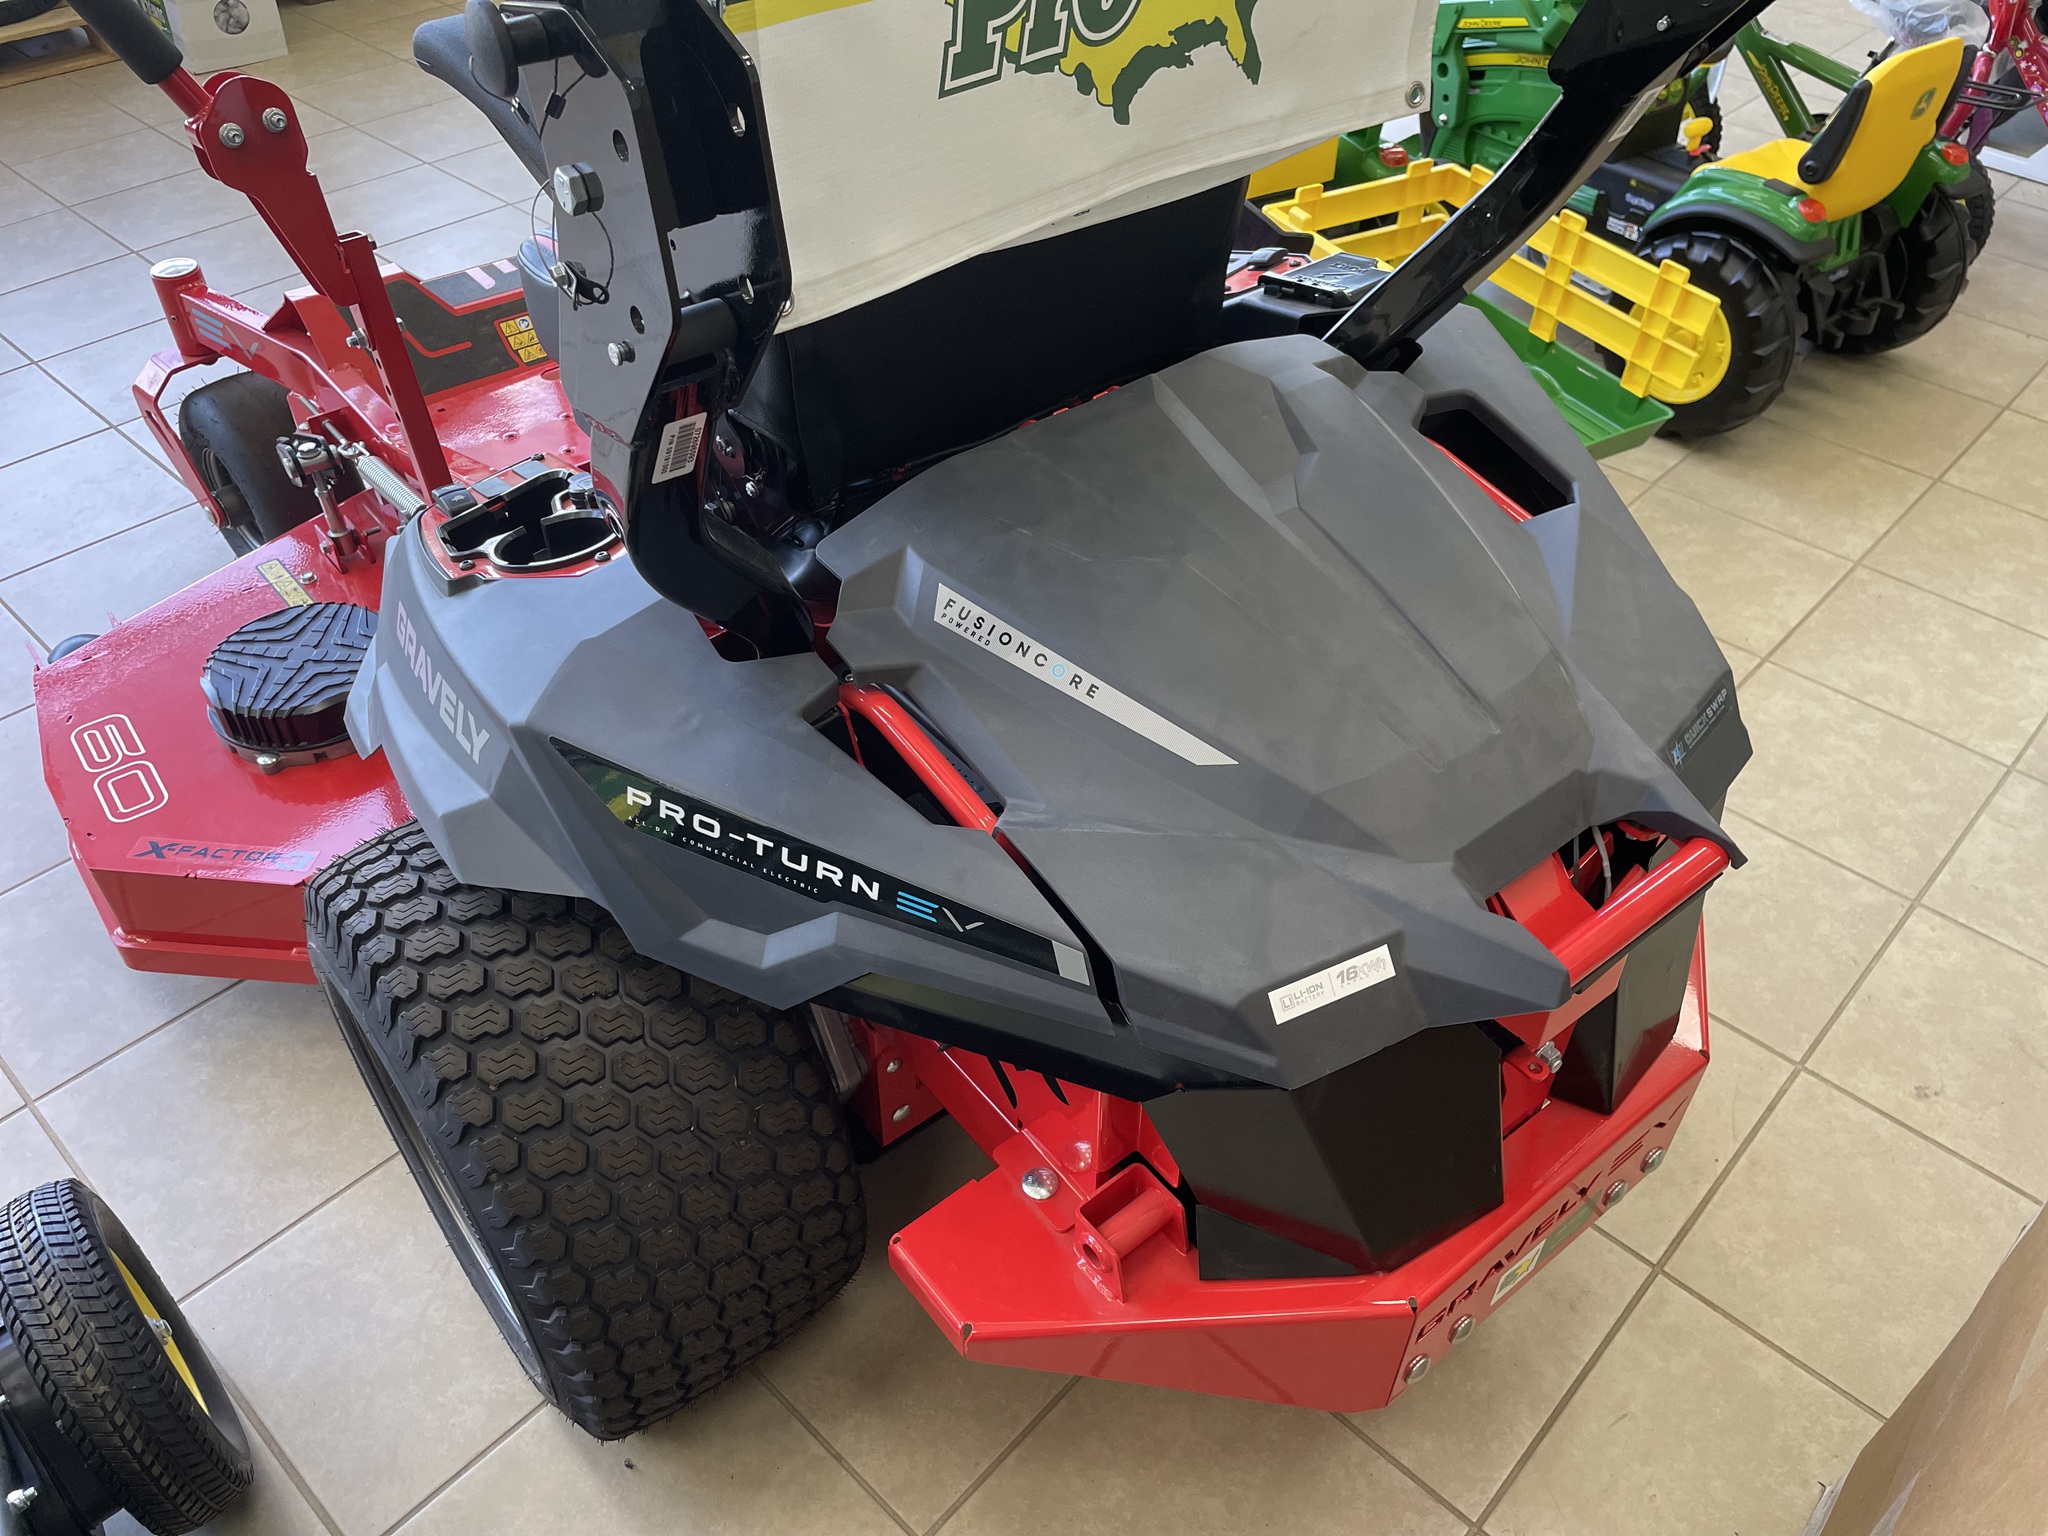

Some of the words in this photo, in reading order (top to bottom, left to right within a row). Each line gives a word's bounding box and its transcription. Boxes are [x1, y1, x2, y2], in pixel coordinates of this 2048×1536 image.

[940, 612, 991, 647] POWERED
[943, 598, 1100, 699] FUSIONCORE
[396, 599, 490, 765] GRAVELY
[70, 713, 169, 823] 60
[133, 840, 283, 863] X-FACTOR
[626, 785, 880, 901] PRO-TURN
[896, 890, 985, 933] EV
[627, 815, 675, 838] ALL-DAY
[682, 835, 755, 870] COMMERCIAL
[762, 867, 820, 895] ELECTRIC
[1293, 981, 1324, 1000] LI-ION
[1295, 990, 1325, 1007] BATTERY
[1415, 1170, 1603, 1345] GRAVELY
